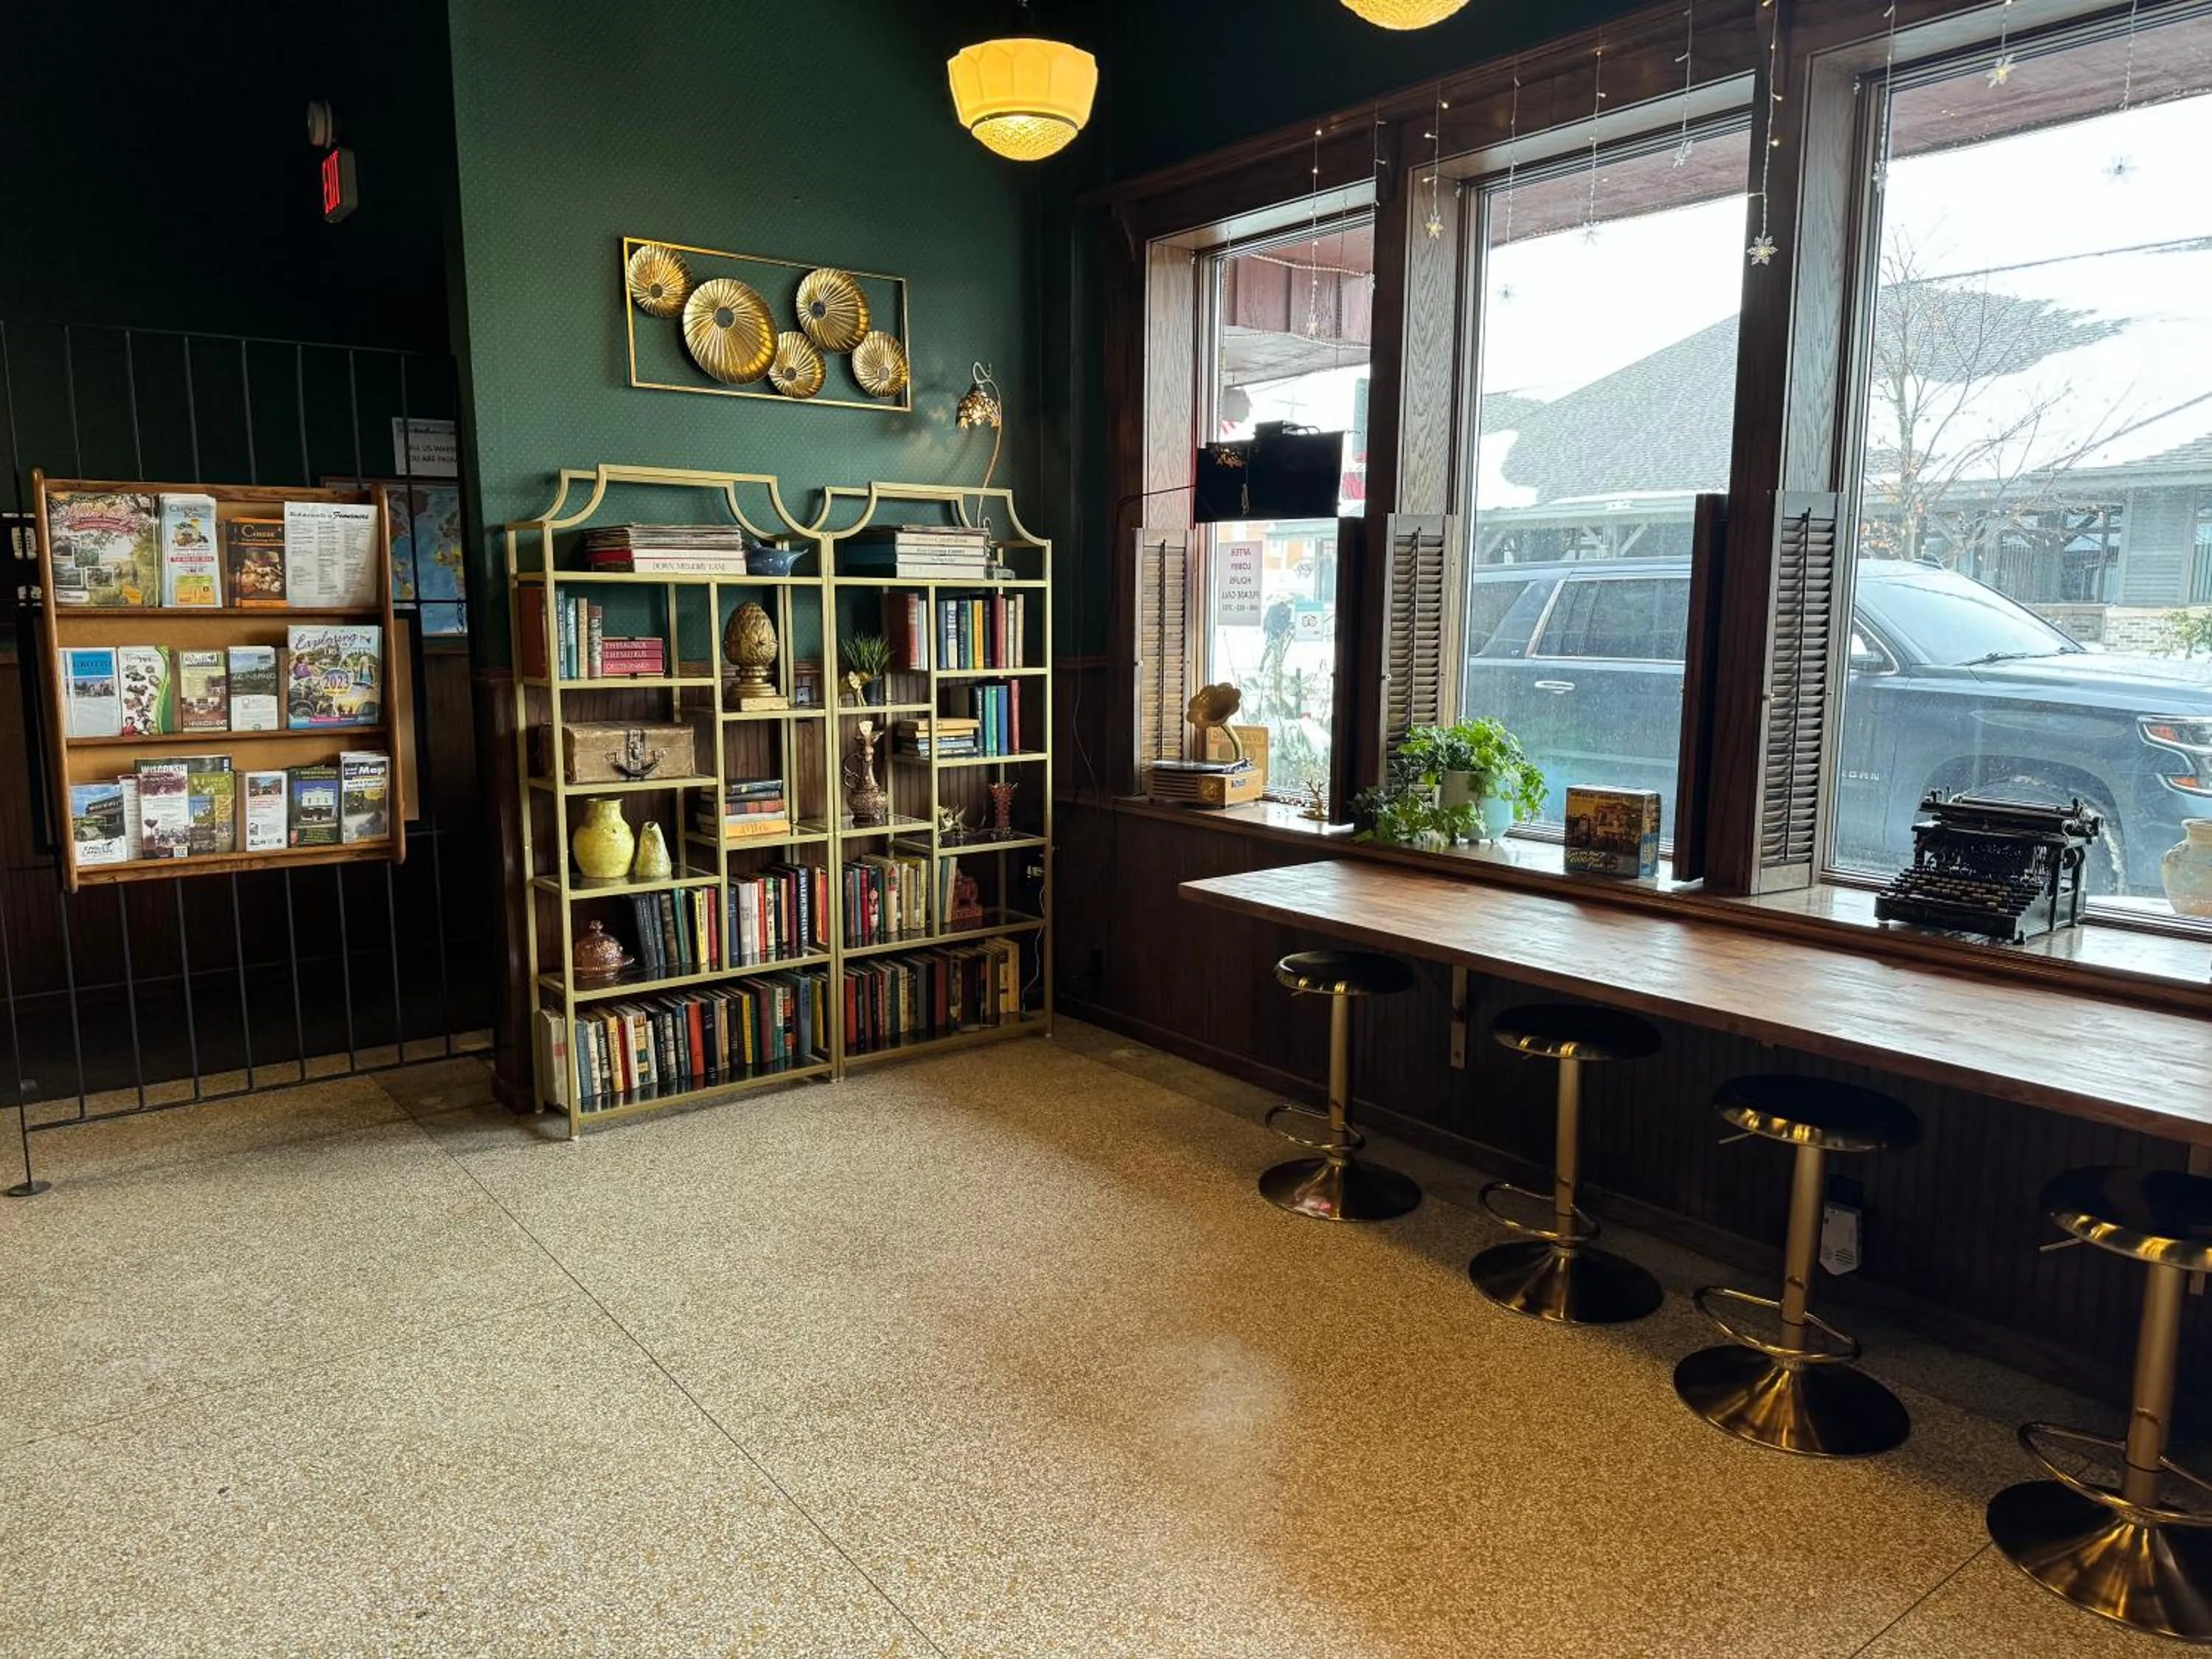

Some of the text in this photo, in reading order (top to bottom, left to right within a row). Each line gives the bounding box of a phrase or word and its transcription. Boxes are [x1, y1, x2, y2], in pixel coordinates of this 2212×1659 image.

[295, 630, 357, 650] Exploring
[324, 675, 349, 689] 2023
[358, 766, 385, 776] Map
